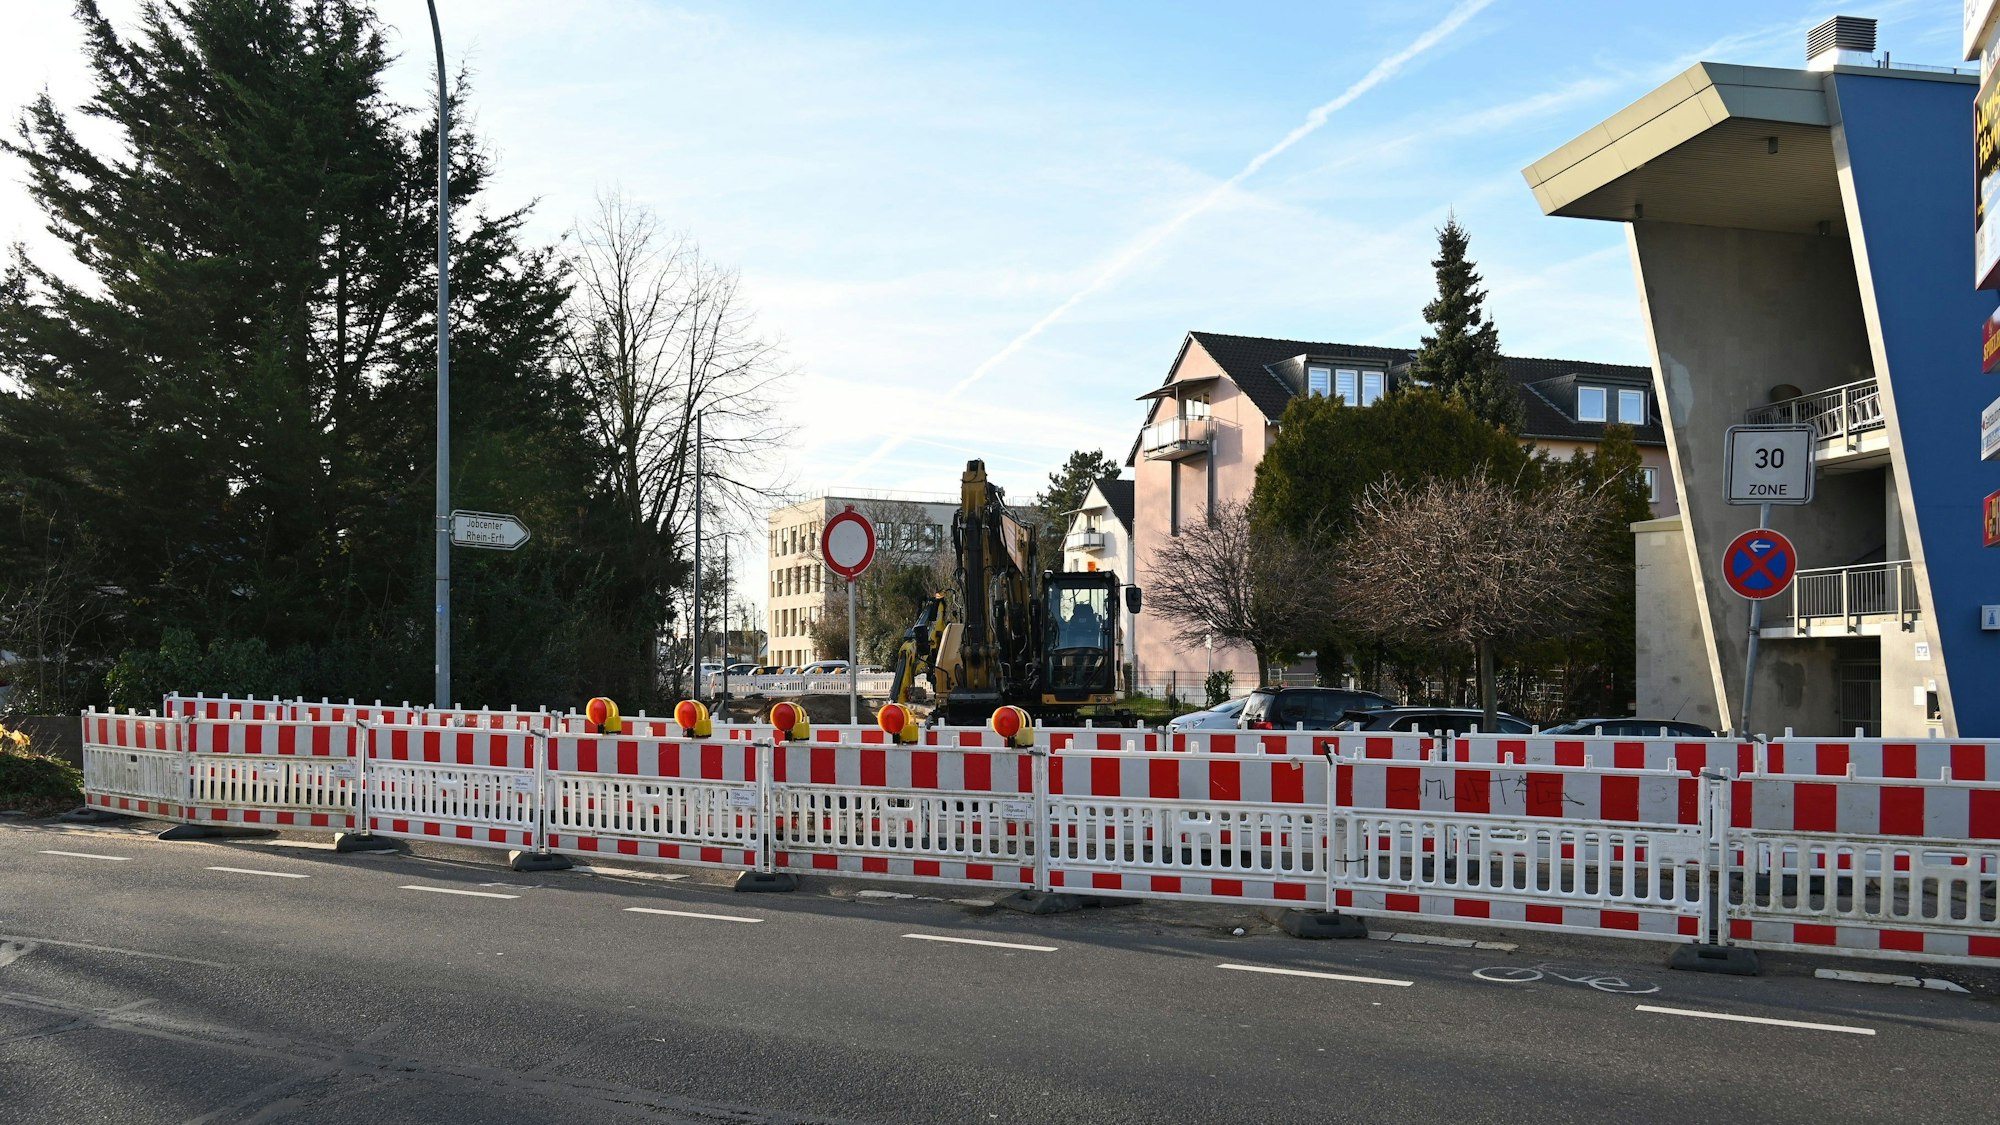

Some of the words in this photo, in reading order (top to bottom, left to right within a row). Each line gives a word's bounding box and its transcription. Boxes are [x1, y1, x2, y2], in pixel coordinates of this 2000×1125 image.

[1755, 448, 1784, 469] 30
[1748, 484, 1788, 496] ZONE
[466, 517, 503, 530] Jobcenter
[466, 531, 505, 543] Rhein-Erft
